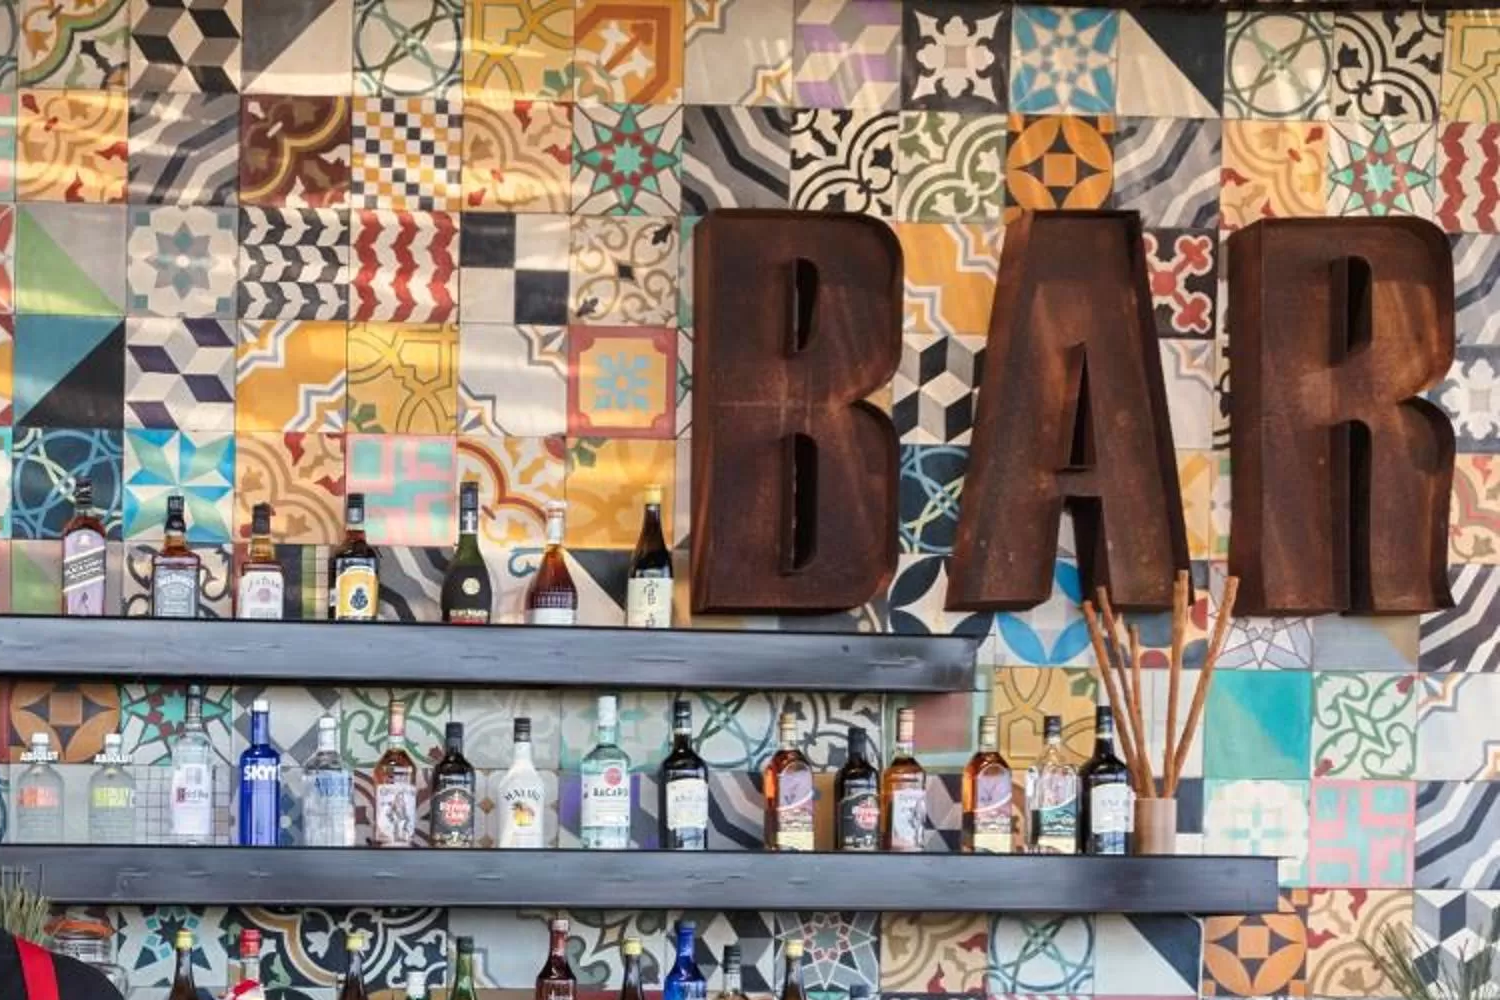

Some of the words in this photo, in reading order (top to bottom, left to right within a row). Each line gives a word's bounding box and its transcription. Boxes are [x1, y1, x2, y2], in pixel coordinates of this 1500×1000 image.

[690, 208, 1455, 617] BAR
[243, 764, 280, 781] SKYY
[593, 787, 628, 797] BACARD
